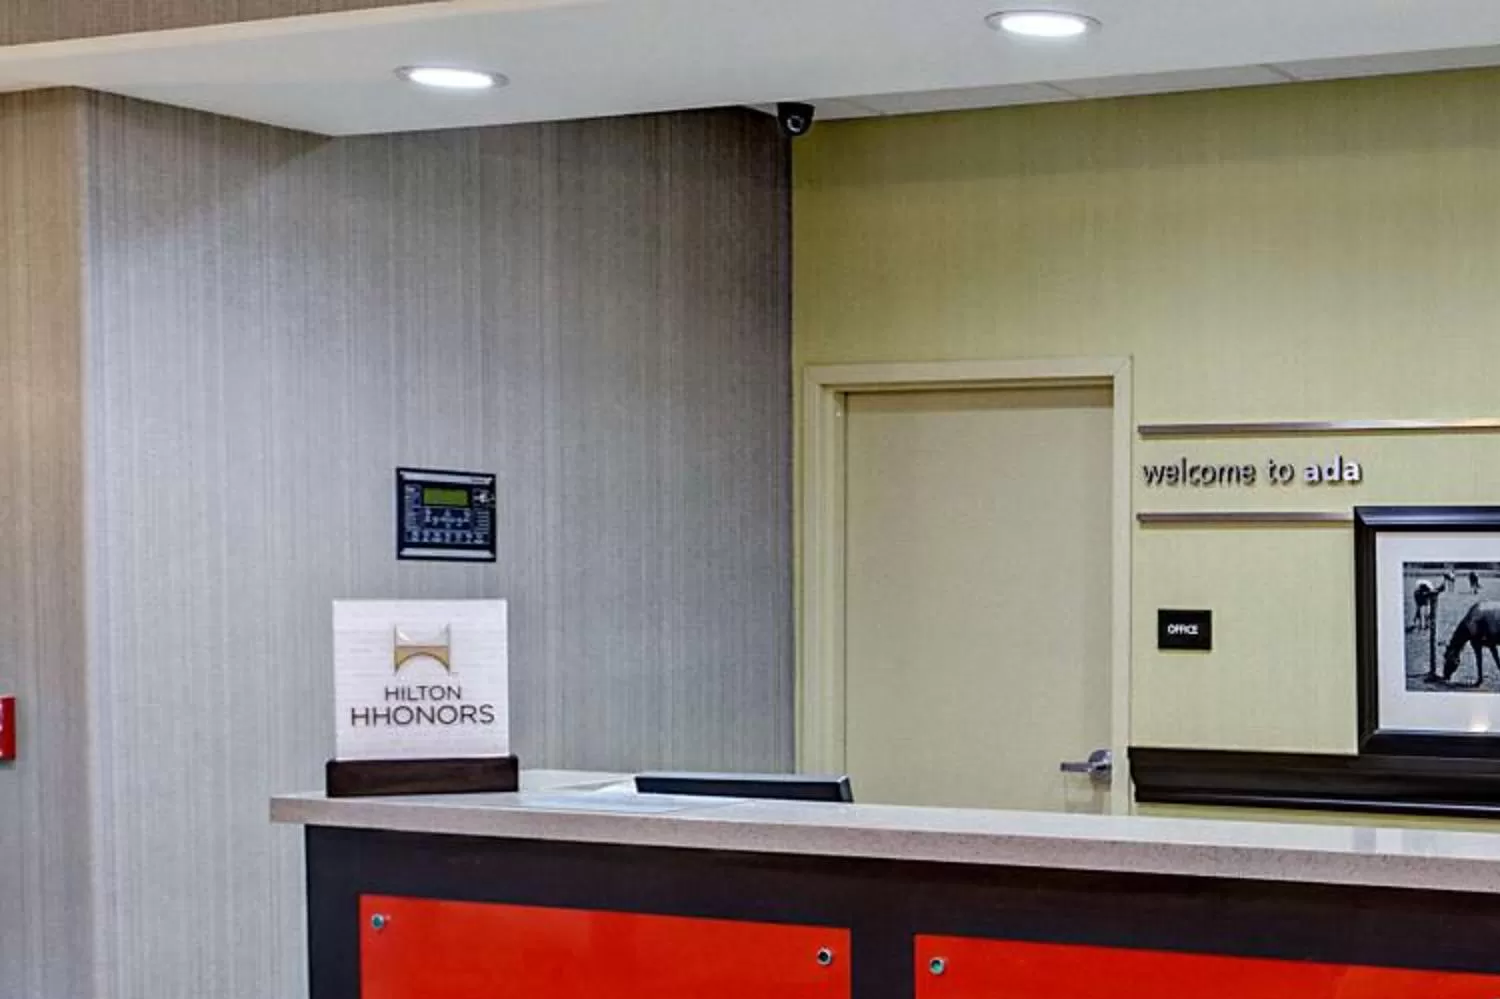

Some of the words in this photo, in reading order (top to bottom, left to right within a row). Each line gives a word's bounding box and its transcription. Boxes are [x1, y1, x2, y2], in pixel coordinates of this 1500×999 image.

[1143, 456, 1256, 486] welcome
[1268, 458, 1295, 485] to
[1303, 454, 1363, 486] ada
[1167, 623, 1199, 635] OFFICE
[384, 685, 462, 702] HILTON
[351, 703, 495, 726] HHONORS
